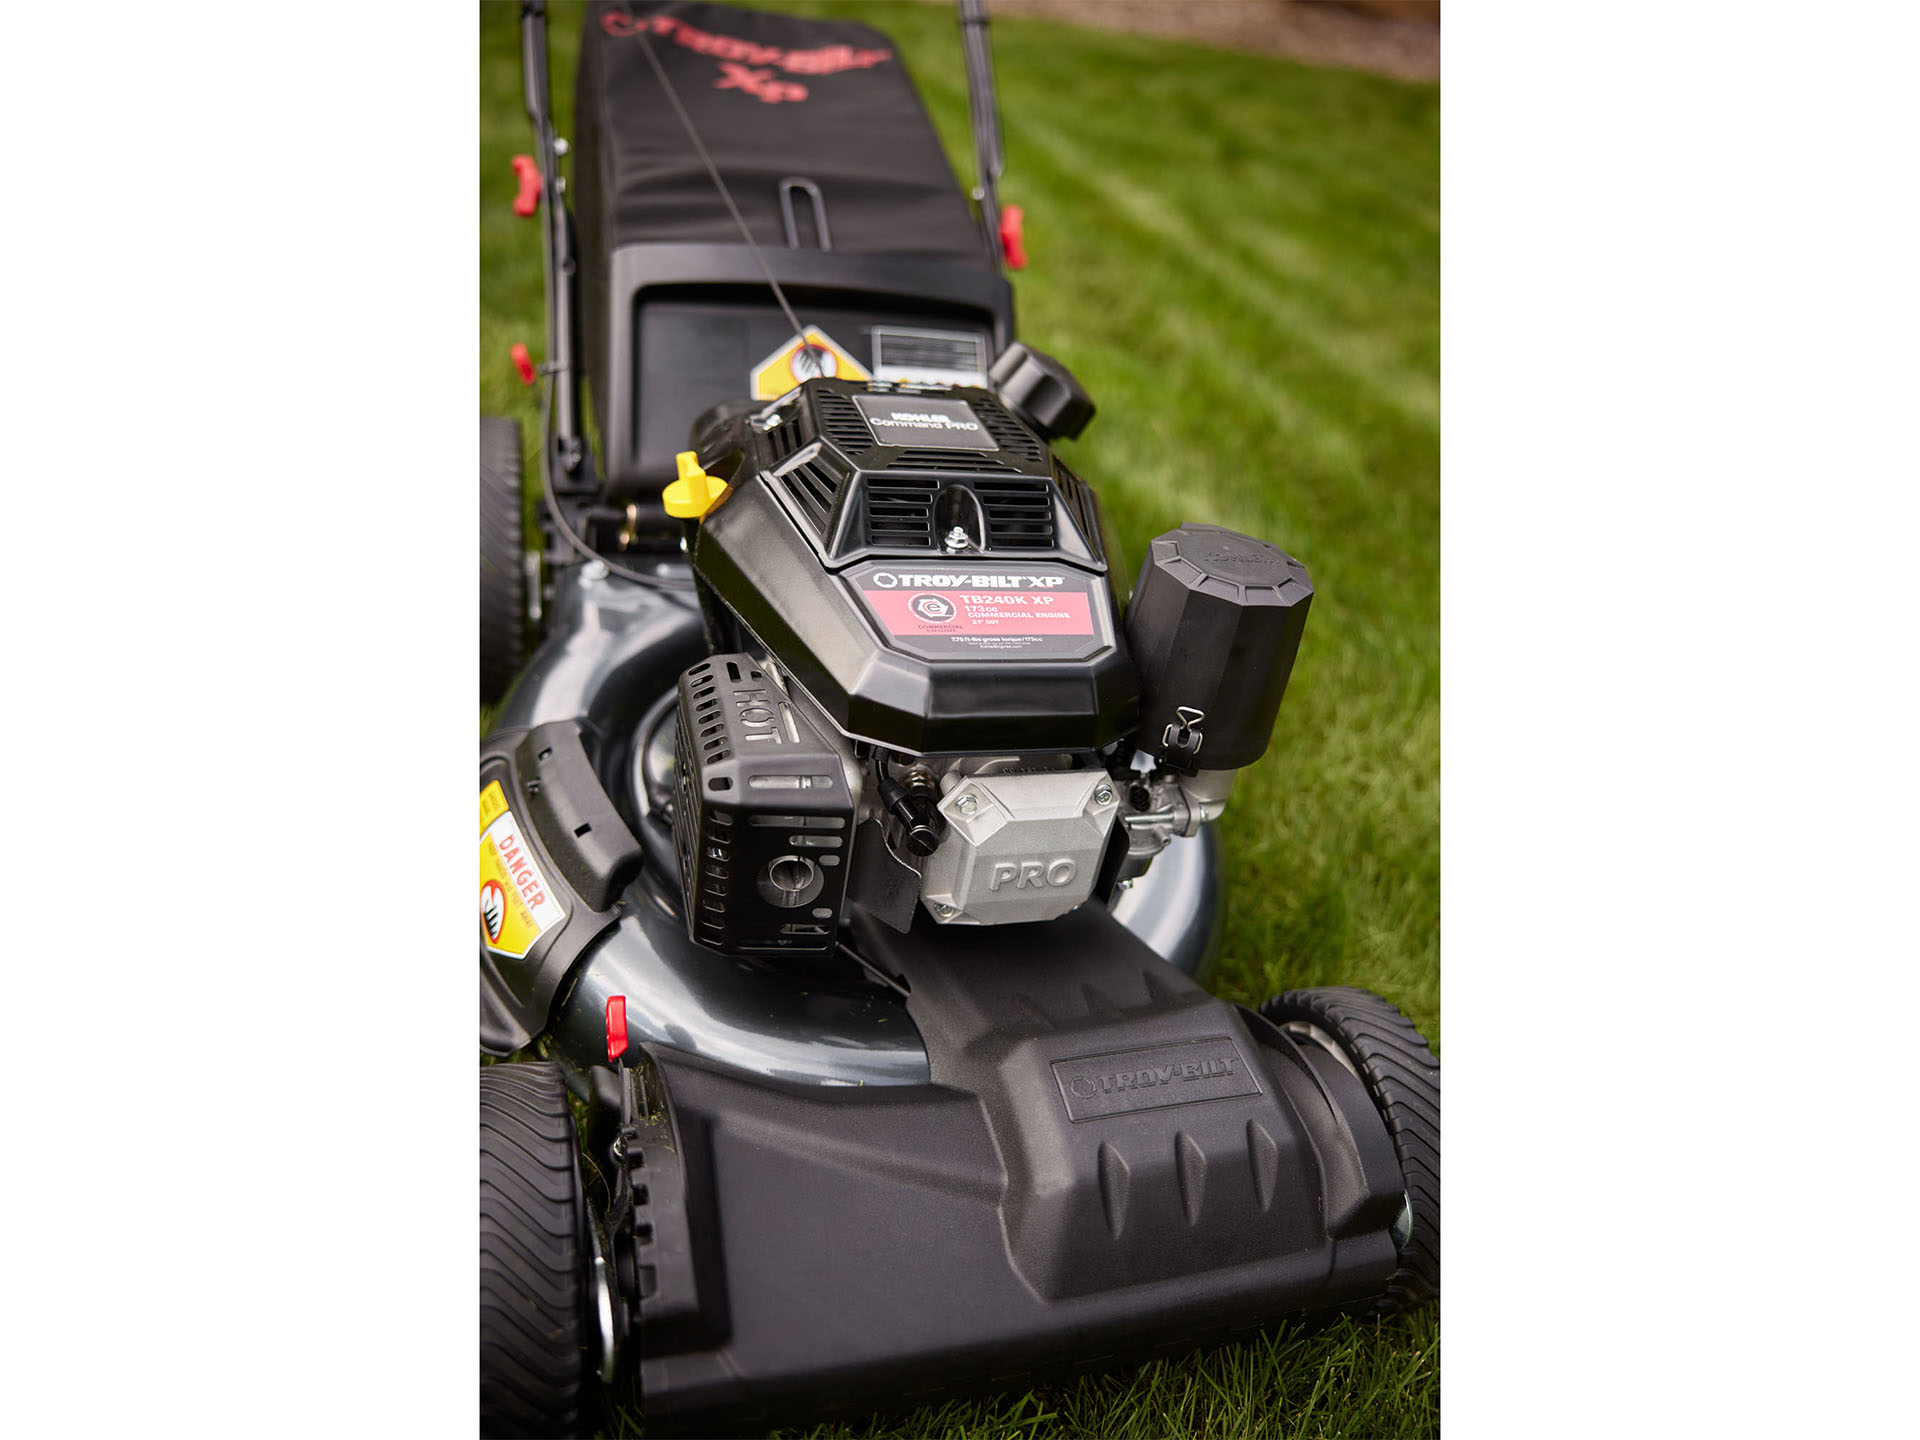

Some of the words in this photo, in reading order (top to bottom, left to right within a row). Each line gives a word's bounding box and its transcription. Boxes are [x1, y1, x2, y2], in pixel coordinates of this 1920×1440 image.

[869, 417, 943, 429] Command
[944, 421, 979, 431] PRO
[1027, 576, 1064, 588] XP
[960, 594, 1028, 605] TB240K
[1031, 596, 1055, 605] XP
[733, 689, 782, 744] HOT
[499, 835, 545, 911] DANGER
[989, 857, 1078, 891] PRO
[1098, 1056, 1239, 1094] TROY-BILT
